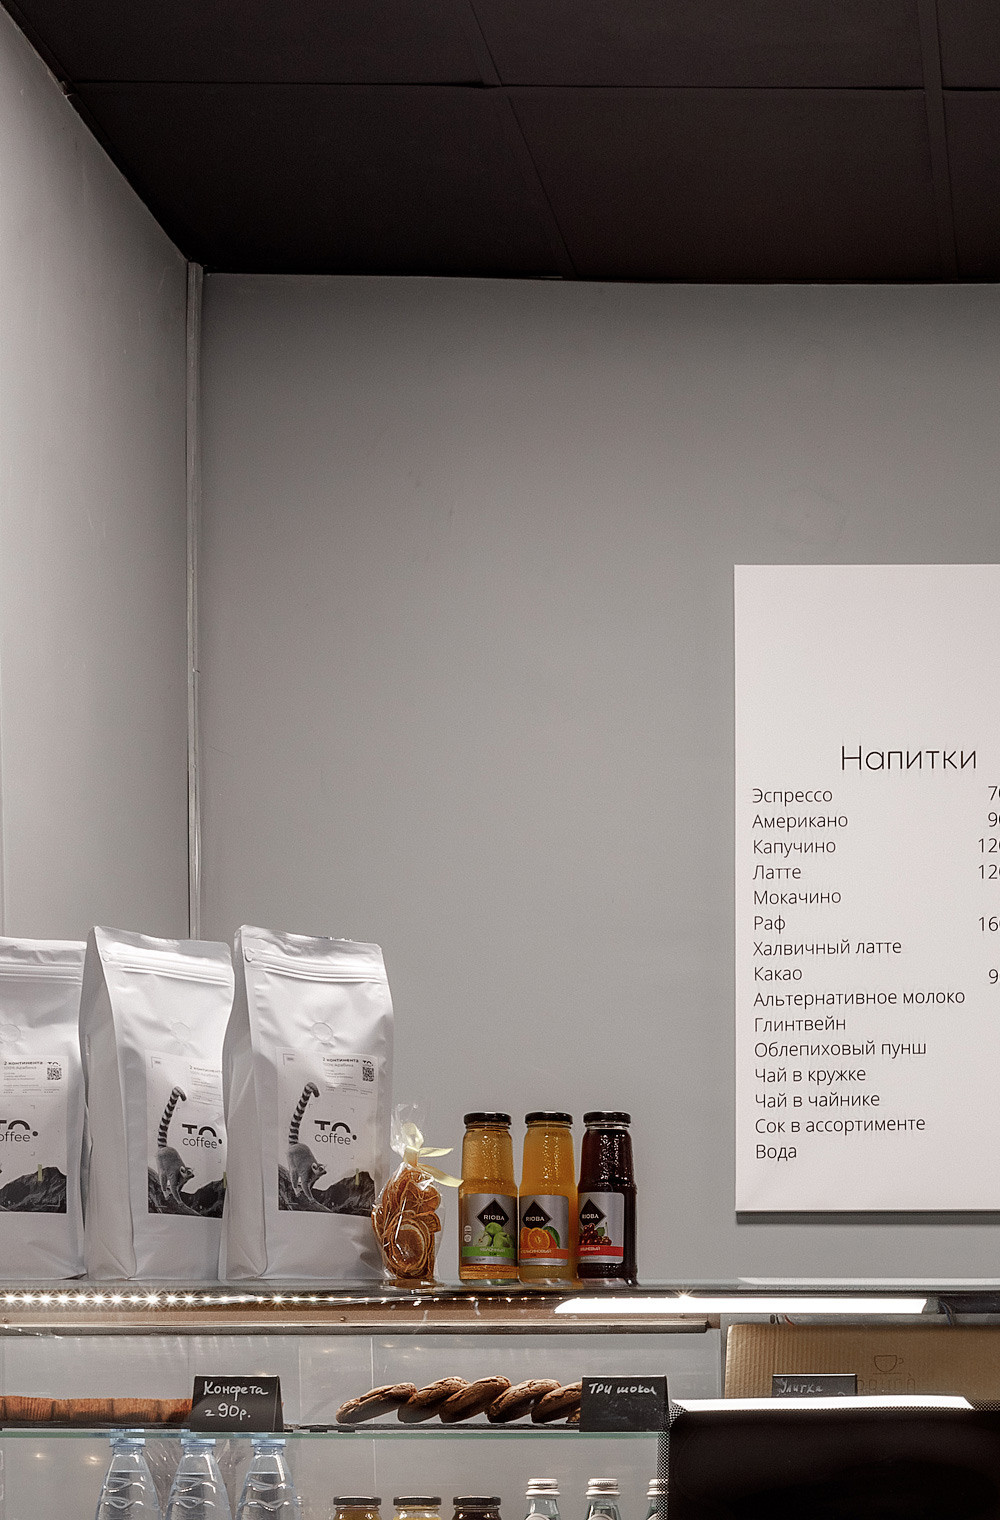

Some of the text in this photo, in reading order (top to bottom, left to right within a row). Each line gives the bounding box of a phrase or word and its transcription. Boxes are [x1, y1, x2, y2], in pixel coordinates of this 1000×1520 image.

[841, 744, 977, 771] Напитки
[751, 787, 833, 808] Эспрессо
[751, 813, 849, 833] Американо
[753, 838, 837, 859] Капучино
[752, 864, 802, 881] Латте
[753, 889, 842, 906] Мокачино
[753, 914, 786, 935] Раф
[752, 938, 902, 957] Халвичный латте
[754, 966, 803, 982] Какао
[752, 991, 966, 1011] Альтернативное молоко
[754, 1014, 846, 1033] Глинтвейн
[754, 1039, 927, 1060] Облепиховый пунш
[754, 1066, 867, 1087] Чай в кружке
[755, 1090, 881, 1109] Чай в чайнике
[0, 1131, 31, 1142] offee
[754, 1118, 926, 1137] Сок в ассортименте
[182, 1137, 218, 1149] coffee
[314, 1133, 352, 1146] coffee
[755, 1143, 797, 1163] Вода
[203, 1380, 269, 1401] Конфета
